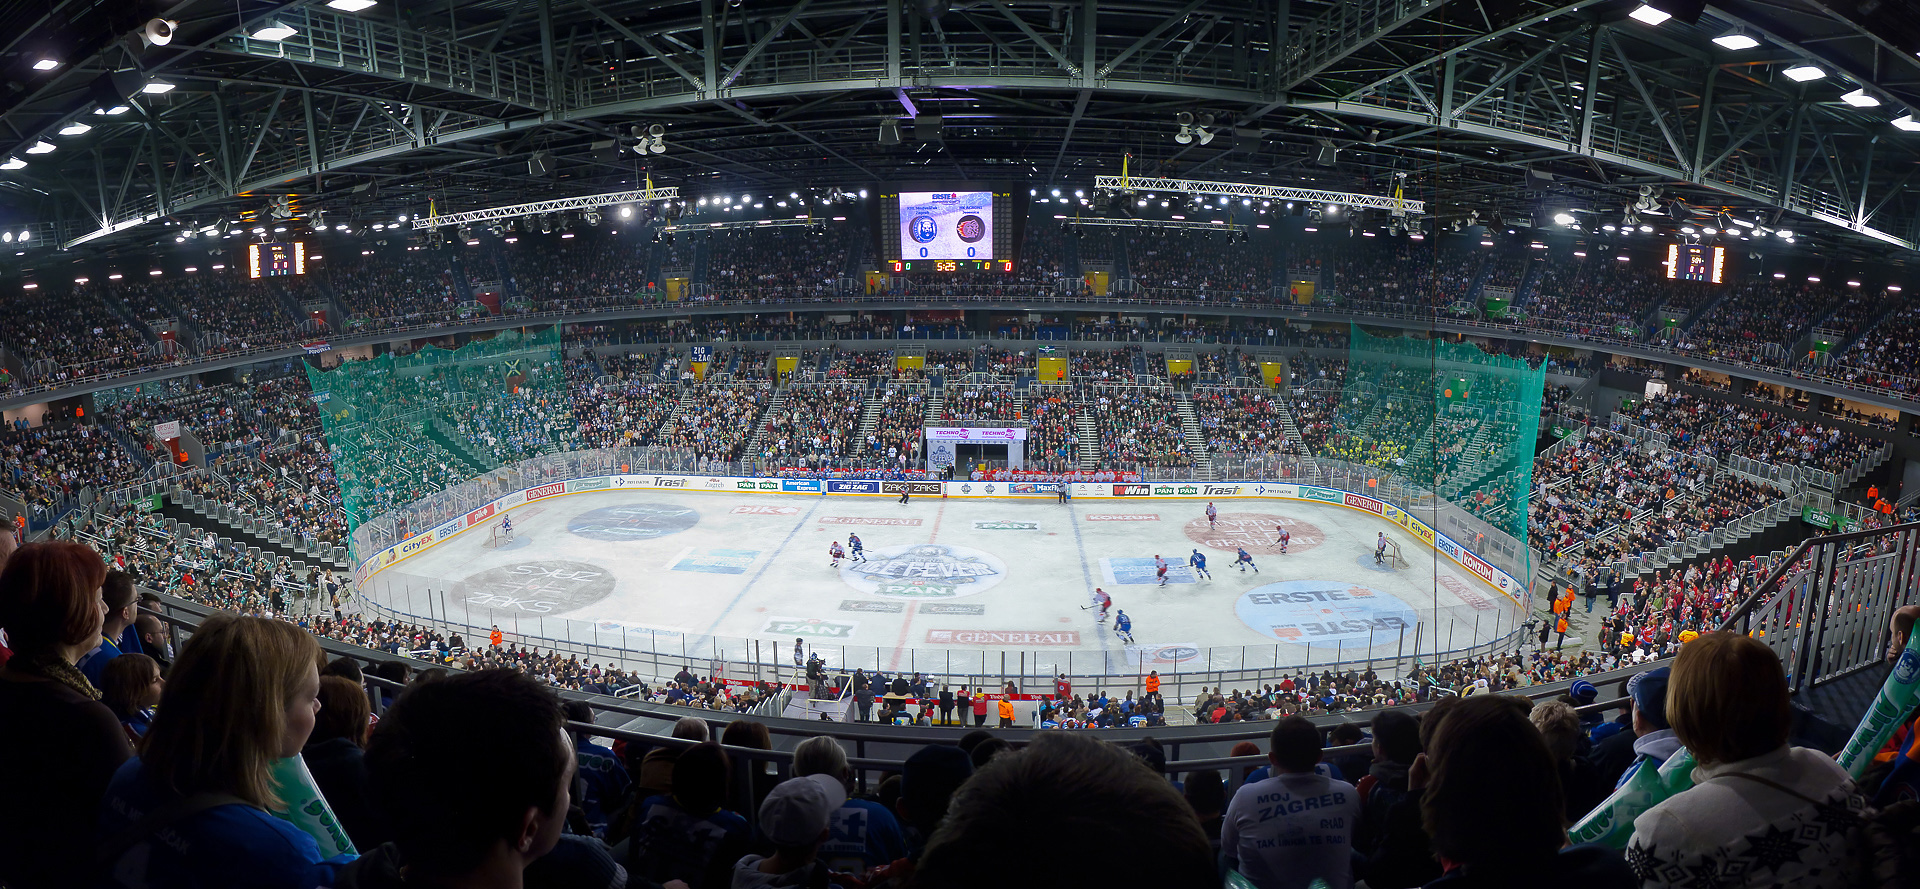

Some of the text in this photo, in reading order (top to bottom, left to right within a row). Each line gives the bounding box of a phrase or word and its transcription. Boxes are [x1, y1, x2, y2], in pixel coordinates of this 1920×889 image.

[920, 247, 928, 257] 0
[967, 247, 976, 257] 0
[895, 262, 902, 271] 0
[906, 262, 912, 270] 0
[937, 262, 956, 271] 5:25
[985, 262, 991, 270] 0
[1005, 262, 1012, 271] 0
[156, 423, 175, 431] URSUS
[654, 477, 687, 487] Trast
[705, 482, 725, 490] Zagreb
[528, 484, 564, 500] GENERALI
[1113, 485, 1149, 495] WWin
[1203, 485, 1240, 495] Trast
[137, 501, 153, 511] PAN
[1346, 496, 1382, 513] GENERALI
[838, 517, 919, 526] GENERALI
[1812, 513, 1829, 523] PAN
[440, 523, 457, 539] ERSTE
[1411, 522, 1433, 541] CityEX
[403, 534, 433, 553] CityEX
[1439, 538, 1454, 556] ERSTE
[902, 560, 996, 577] FEVER
[1464, 553, 1493, 579] KONZUM
[508, 565, 602, 582] ZAKS
[886, 586, 948, 595] PAN
[463, 591, 560, 613] ZAKS
[1248, 590, 1350, 605] ERSTE
[776, 623, 842, 635] PAN
[1301, 617, 1411, 636] ERSTE
[956, 632, 1074, 644] GENERALI
[1257, 793, 1290, 804] MOJ
[1258, 792, 1347, 823] ZAGREB
[1256, 838, 1275, 849] TAK
[1309, 836, 1322, 845] TE
